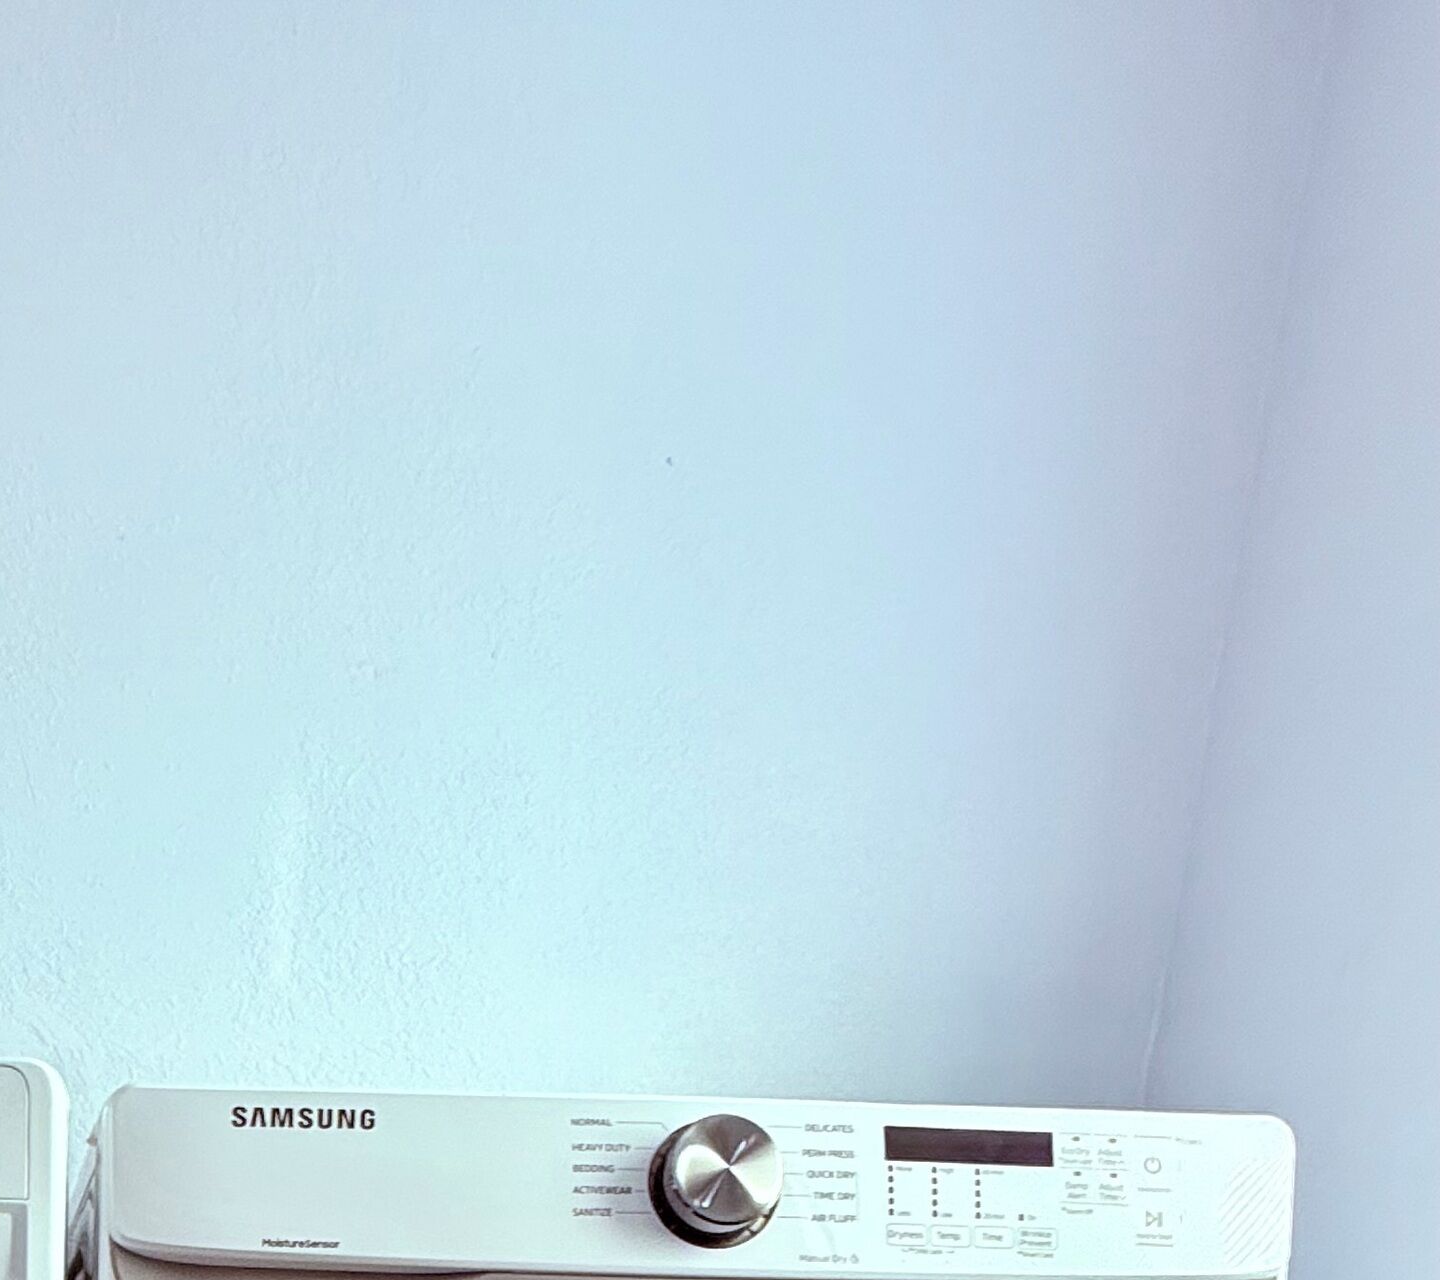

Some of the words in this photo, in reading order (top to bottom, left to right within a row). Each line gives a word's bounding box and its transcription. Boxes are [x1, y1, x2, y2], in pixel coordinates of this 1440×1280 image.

[230, 1106, 377, 1131] SAMSUNG
[570, 1118, 614, 1127] NORMAL
[804, 1123, 855, 1134] DELICATES
[571, 1143, 604, 1152] HEAVY
[605, 1143, 632, 1152] DUTY
[572, 1164, 616, 1174] BEDDING
[806, 1170, 835, 1179] QUICK
[836, 1170, 857, 1179] DRY
